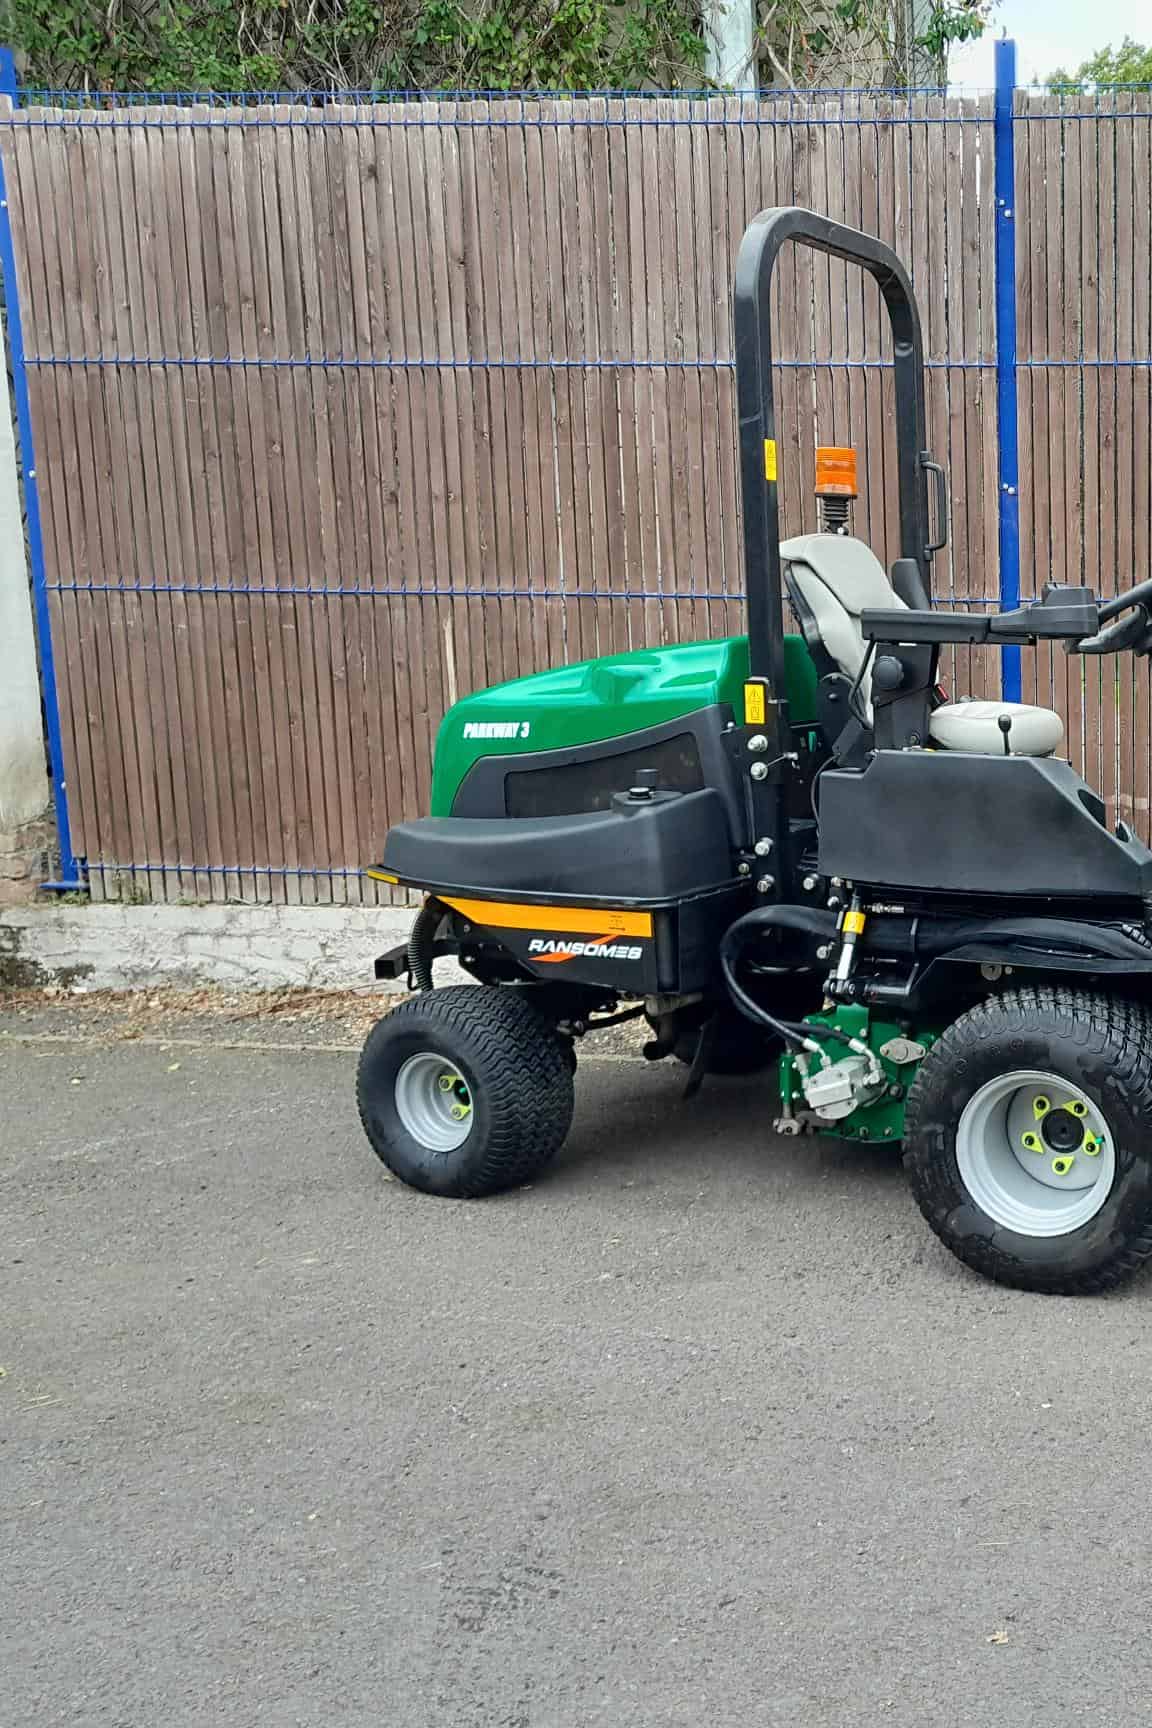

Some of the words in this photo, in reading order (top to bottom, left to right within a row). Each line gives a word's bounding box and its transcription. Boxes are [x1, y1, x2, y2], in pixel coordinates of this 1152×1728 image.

[463, 721, 520, 739] PARKWAY
[520, 721, 530, 738] 3
[528, 939, 643, 960] RANSOMES
